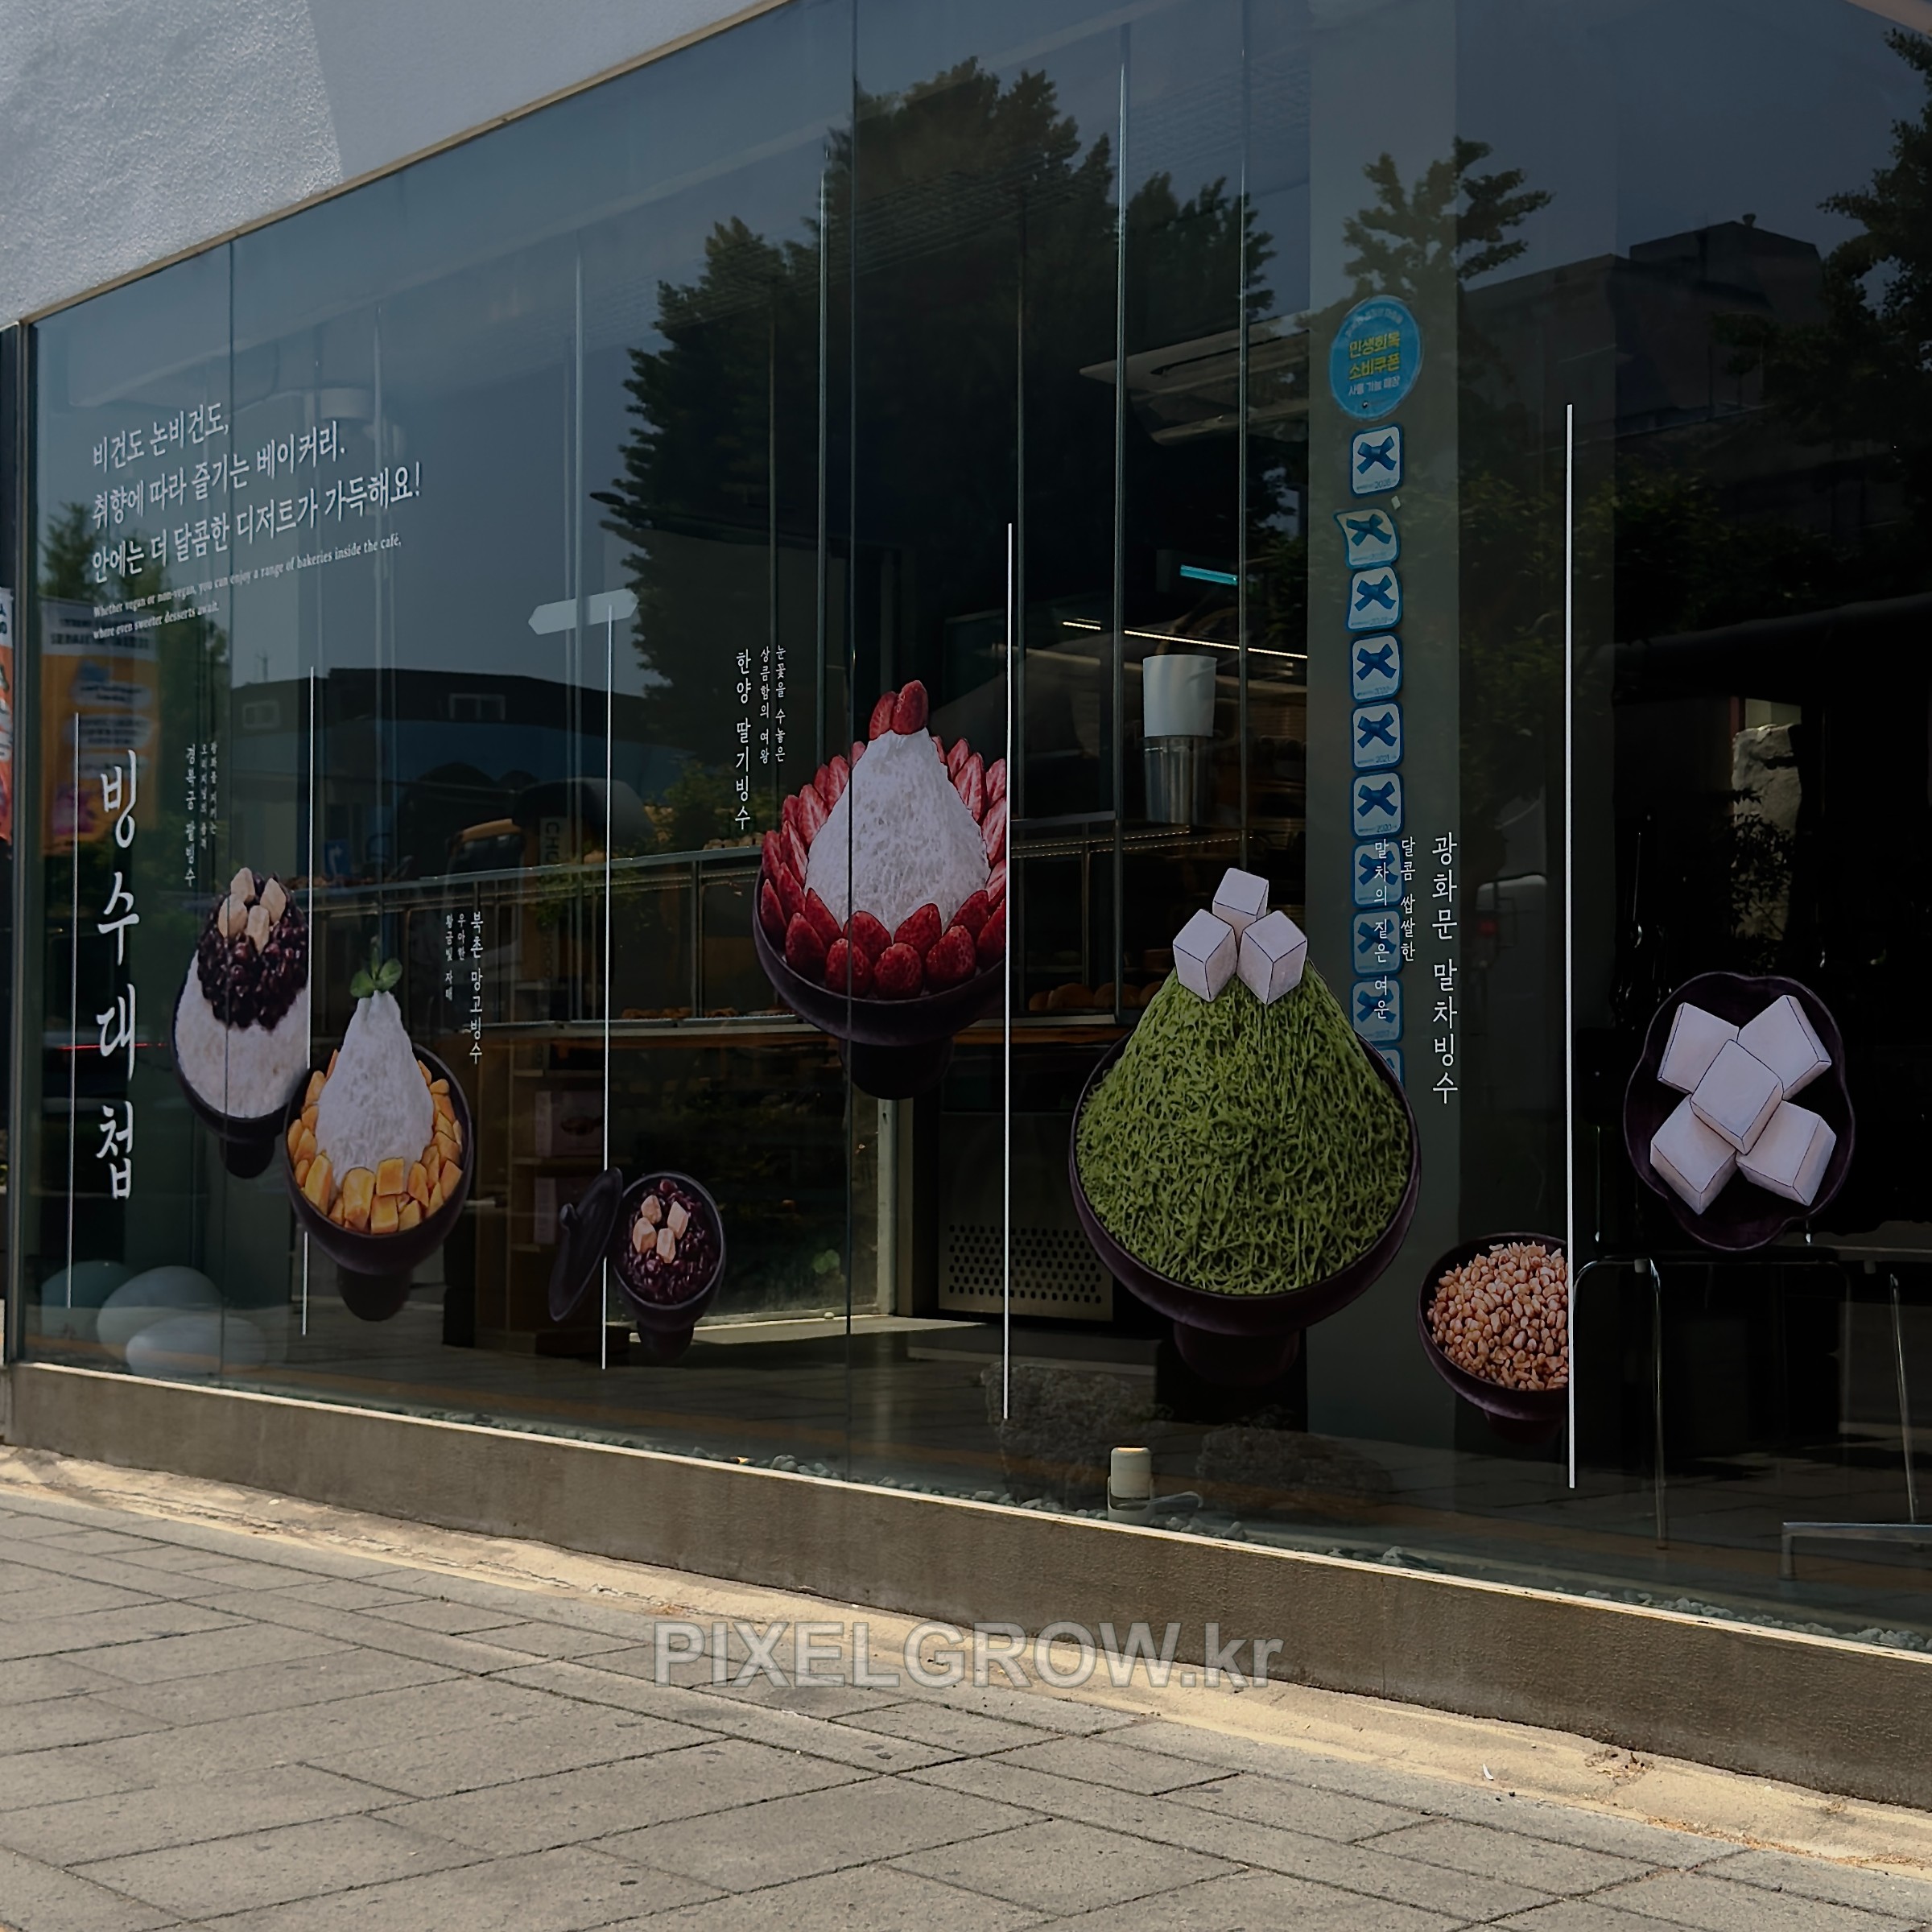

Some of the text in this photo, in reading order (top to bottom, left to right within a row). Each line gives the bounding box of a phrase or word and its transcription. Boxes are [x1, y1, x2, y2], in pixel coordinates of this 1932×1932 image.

[1349, 331, 1401, 359] 민생회복
[1349, 353, 1400, 381] 소비쿠폰
[93, 402, 229, 473] 비건도 논비건도,
[93, 420, 346, 530] 취향에 따라 즐기는 베이커리.
[93, 461, 422, 584] 안에는 더 달콤한 디저트가 가득해요!
[93, 603, 123, 618] Whether
[126, 598, 146, 612] vegan
[147, 595, 155, 605] or
[214, 576, 228, 588] can
[230, 570, 251, 586] enjoy
[253, 571, 258, 579] a
[261, 563, 283, 578] range
[286, 557, 295, 571] of
[297, 551, 332, 569] bakeries
[335, 543, 361, 560] inside
[364, 539, 378, 554] the
[116, 623, 133, 635] even
[134, 615, 163, 631] sweeter
[164, 607, 196, 624] desserts
[734, 648, 752, 831] 한양 딸기빙수
[759, 646, 770, 765] 상큼함의 여왕
[774, 644, 786, 762] 눈꽃을 수놓은
[184, 743, 196, 888] 경복궁 팥빙수
[1373, 839, 1389, 906] 말차의
[1400, 836, 1416, 962] 달콤 쌉쌀한
[96, 749, 139, 1200] 빙수대첩
[456, 912, 467, 962] 우아한
[469, 911, 484, 1066] 북촌 망고빙수
[1373, 919, 1389, 964] 짙은
[1432, 832, 1459, 1104] 광화문 말차빙수
[1373, 976, 1389, 1020] 여운
